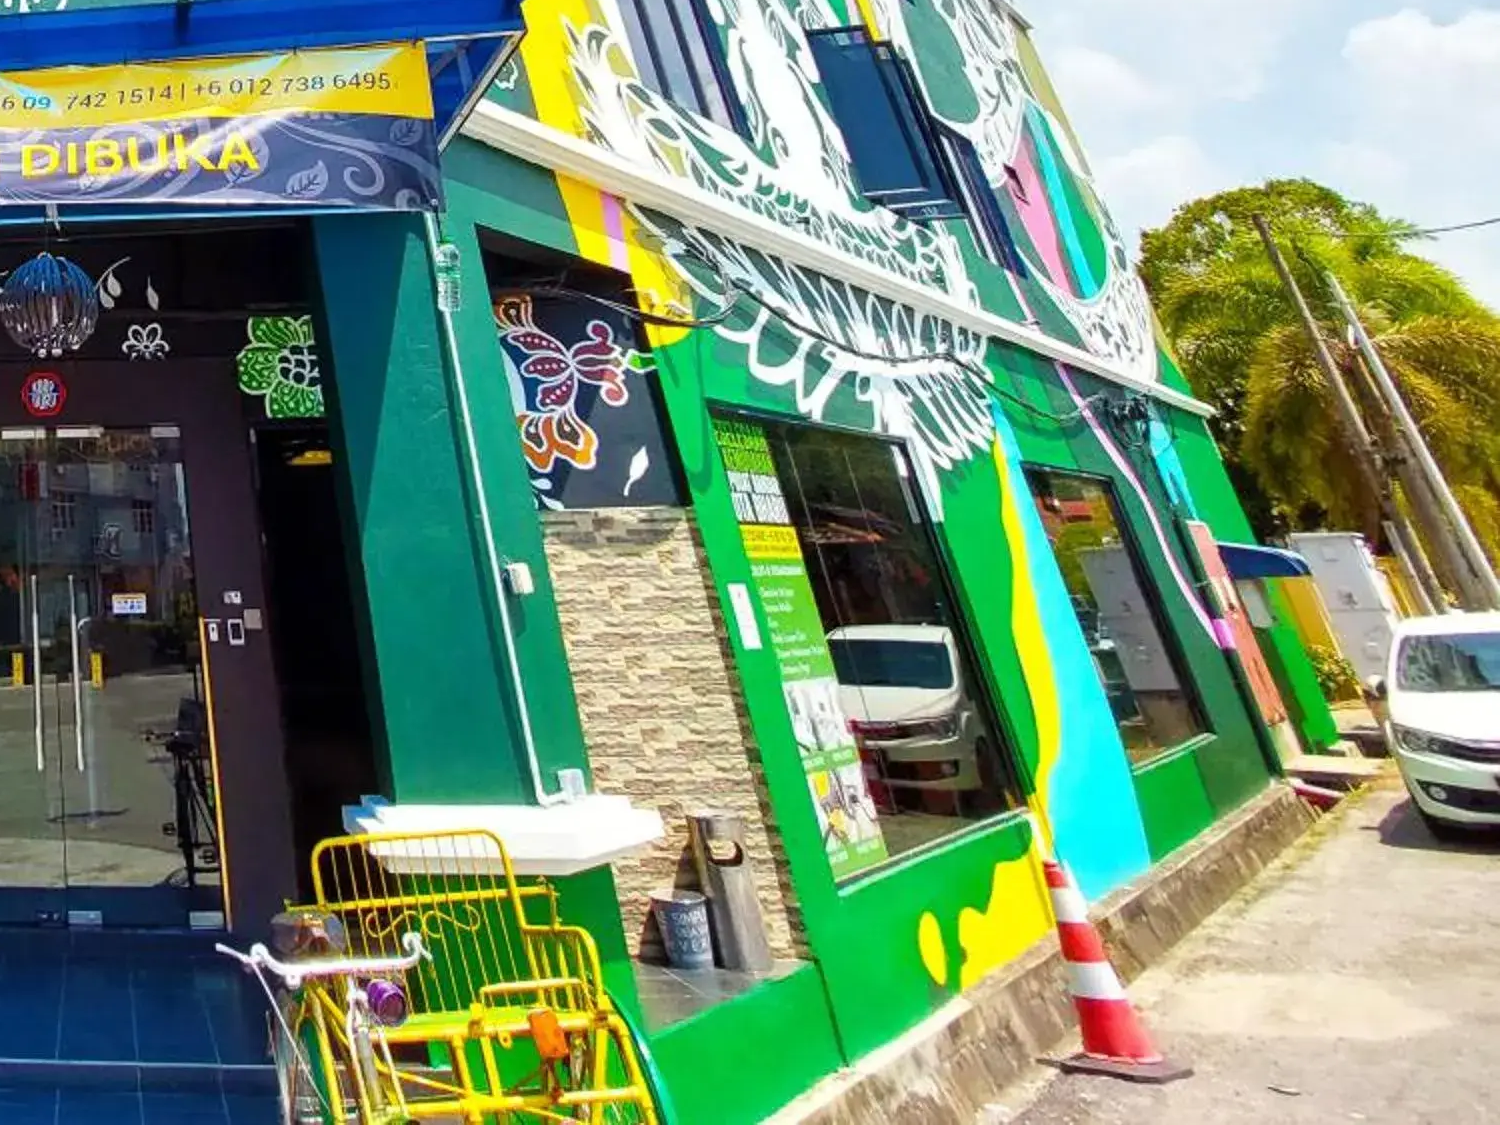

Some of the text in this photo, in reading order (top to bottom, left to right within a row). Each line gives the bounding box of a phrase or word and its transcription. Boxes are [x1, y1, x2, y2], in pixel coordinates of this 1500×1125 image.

[23, 94, 52, 110] 09
[66, 92, 108, 111] 742
[115, 84, 173, 106] 1514
[193, 79, 222, 96] +6
[228, 77, 274, 95] 012
[282, 73, 326, 92] 738
[332, 71, 391, 89] 6495
[20, 131, 260, 179] DIBUKA
